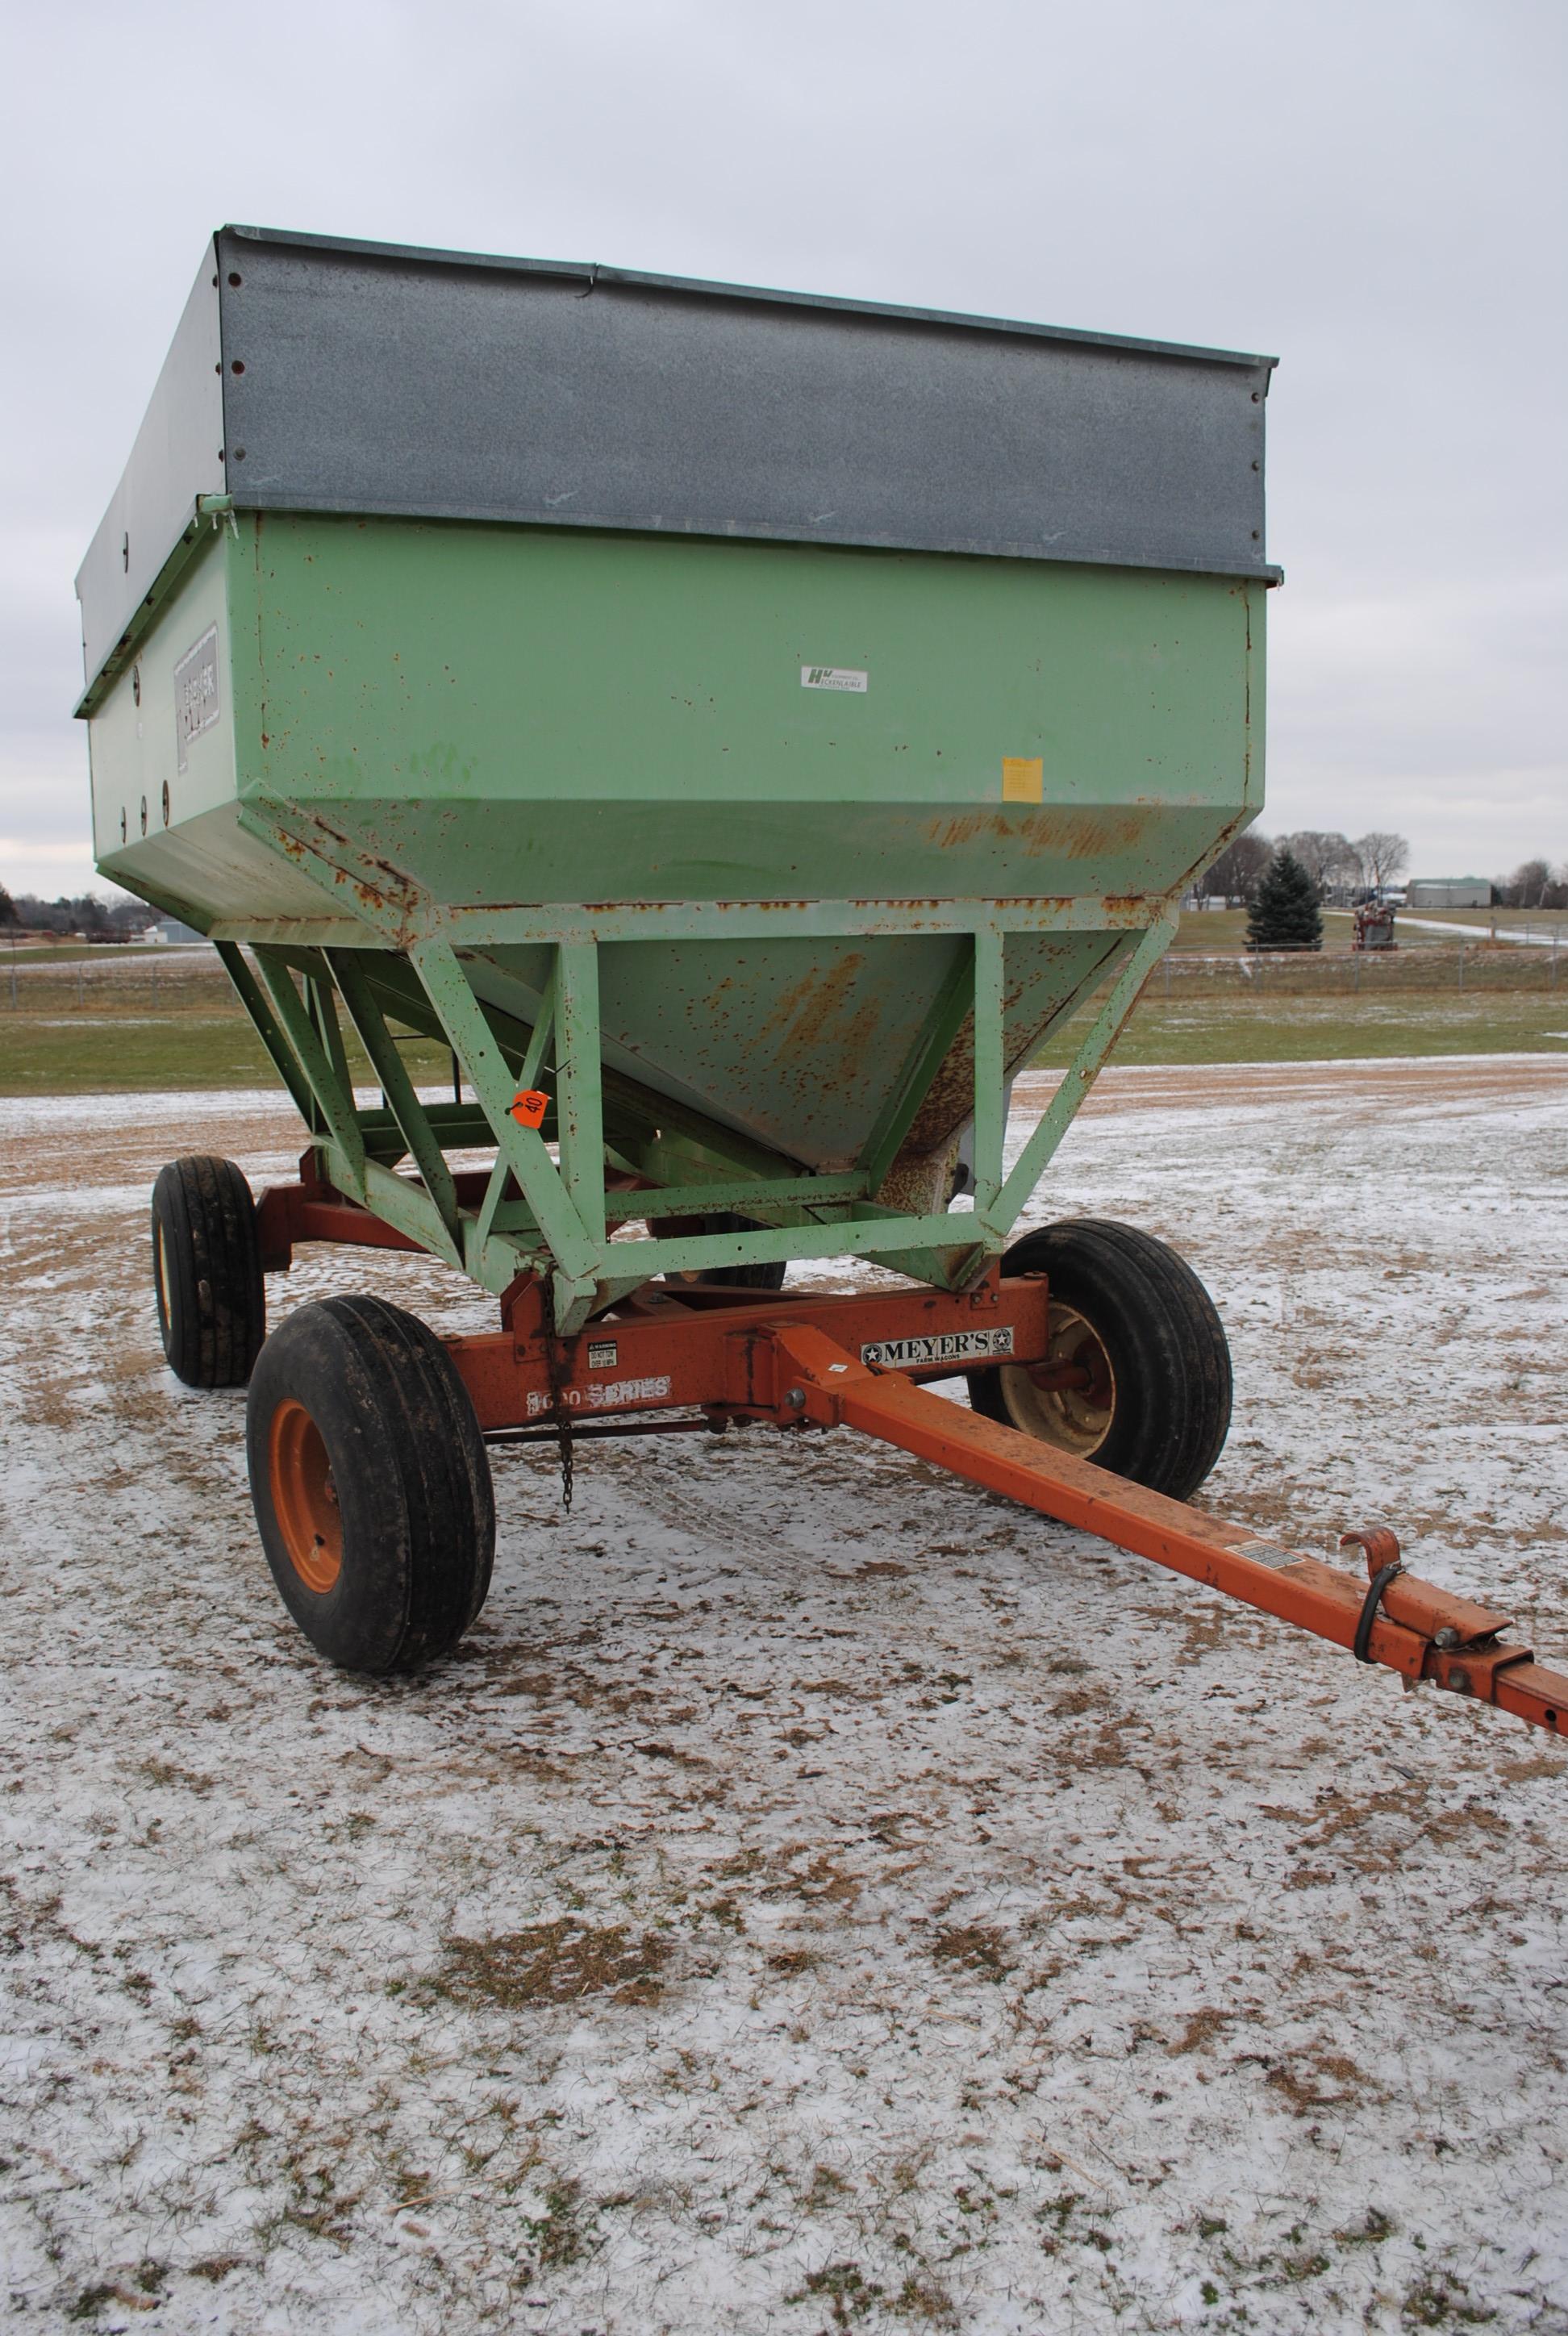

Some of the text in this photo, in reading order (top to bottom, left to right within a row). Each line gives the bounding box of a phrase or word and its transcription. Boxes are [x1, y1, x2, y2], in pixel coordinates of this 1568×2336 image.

[525, 1097, 542, 1113] 40
[885, 1333, 988, 1362] MEYER'S
[934, 1354, 960, 1362] WAGONS
[586, 1376, 670, 1407] SERIES
